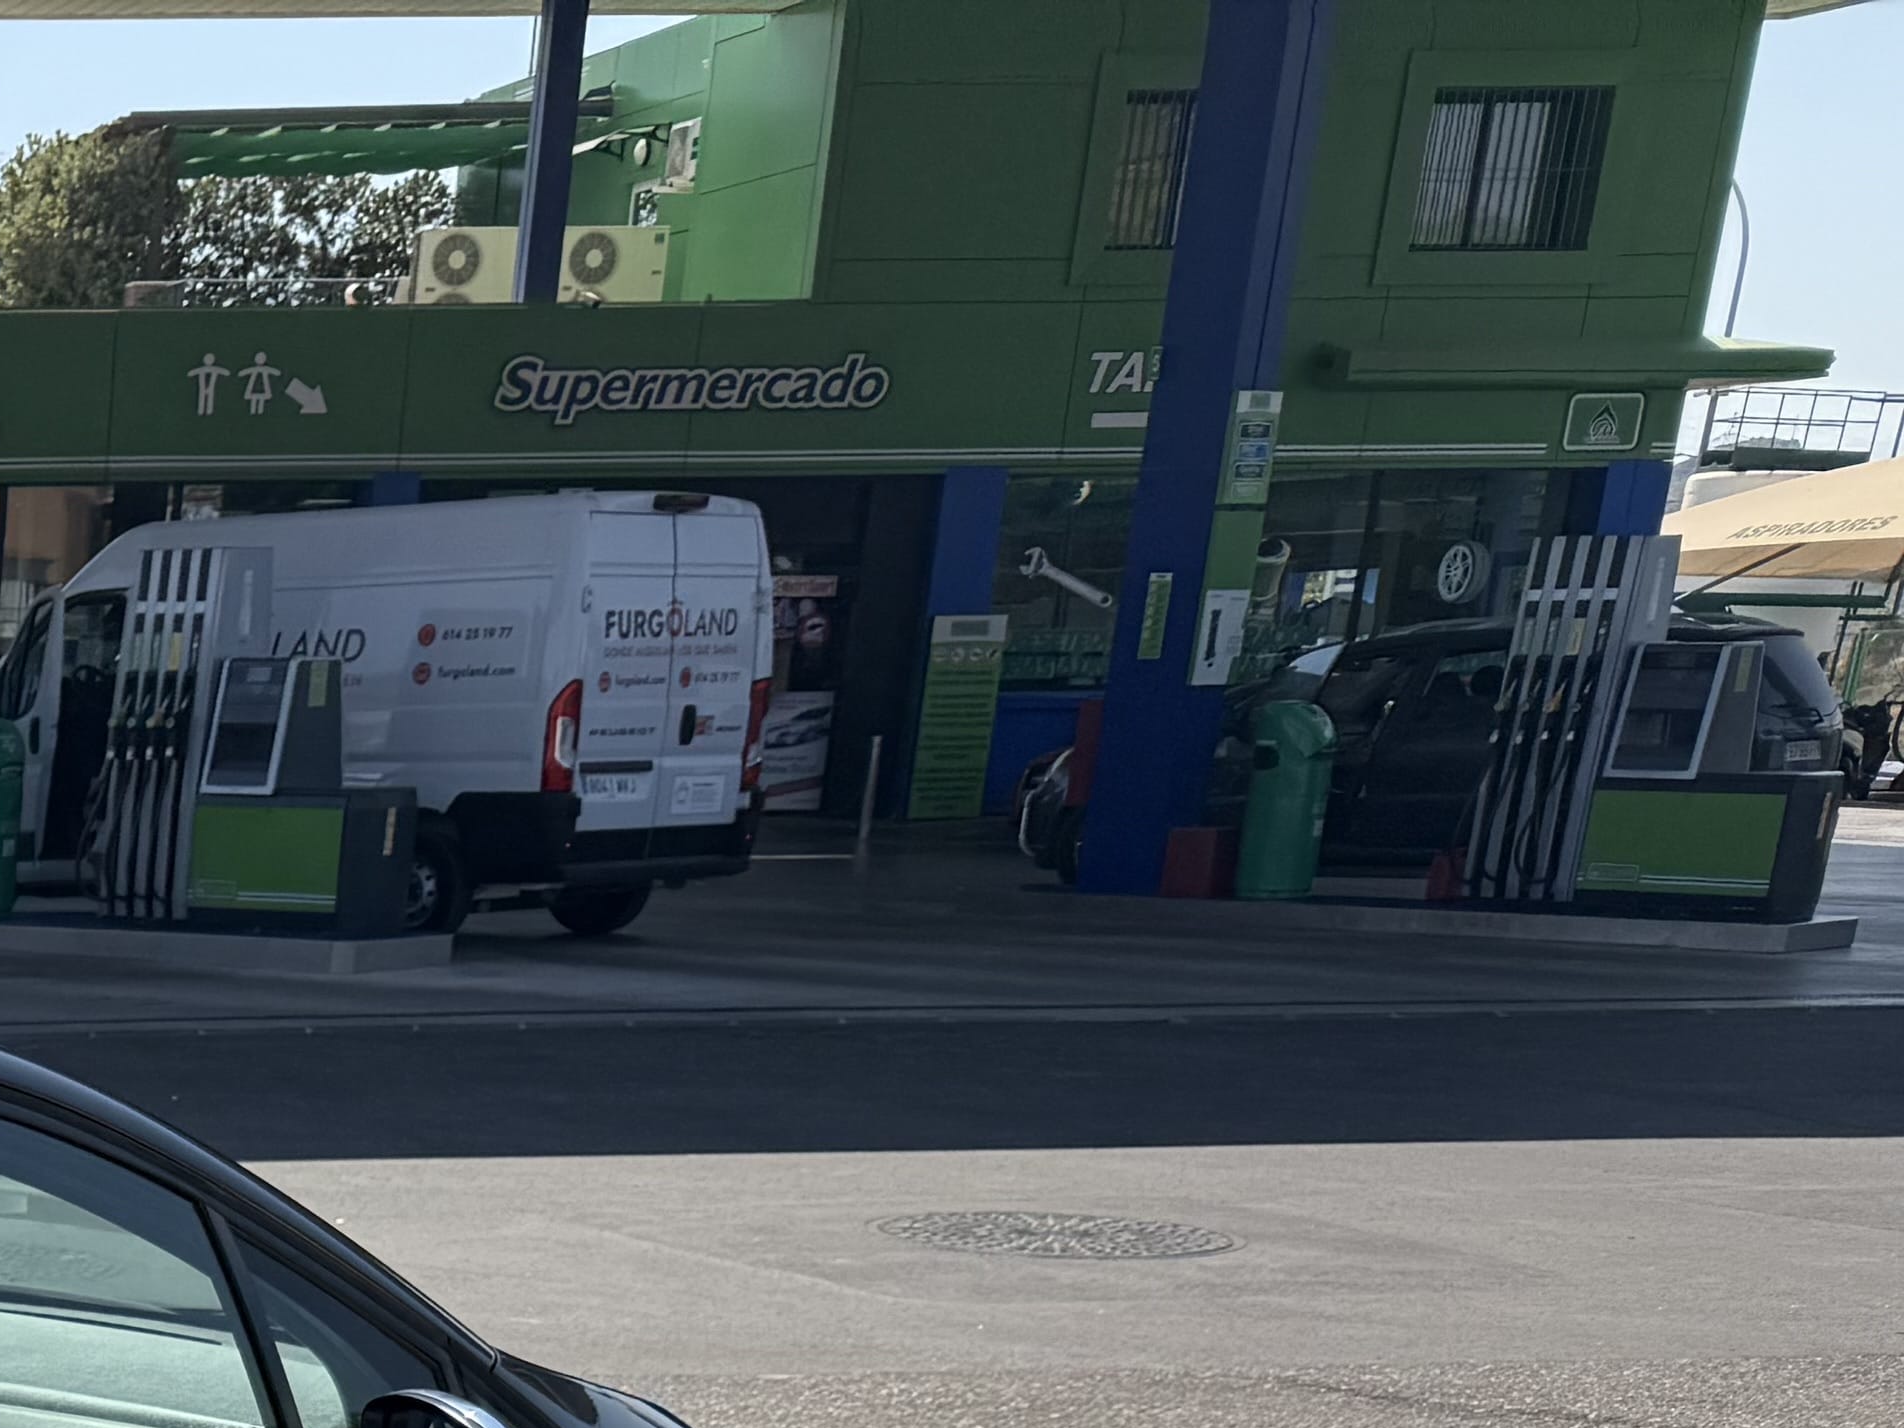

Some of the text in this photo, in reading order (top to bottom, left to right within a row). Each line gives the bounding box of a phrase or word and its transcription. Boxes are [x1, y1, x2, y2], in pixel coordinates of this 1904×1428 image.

[494, 352, 890, 425] Supermercado
[1727, 515, 1898, 539] ASPIRADORES
[498, 626, 513, 639] 77
[604, 606, 738, 639] FURGOLAND
[438, 663, 516, 680] furgoland.com
